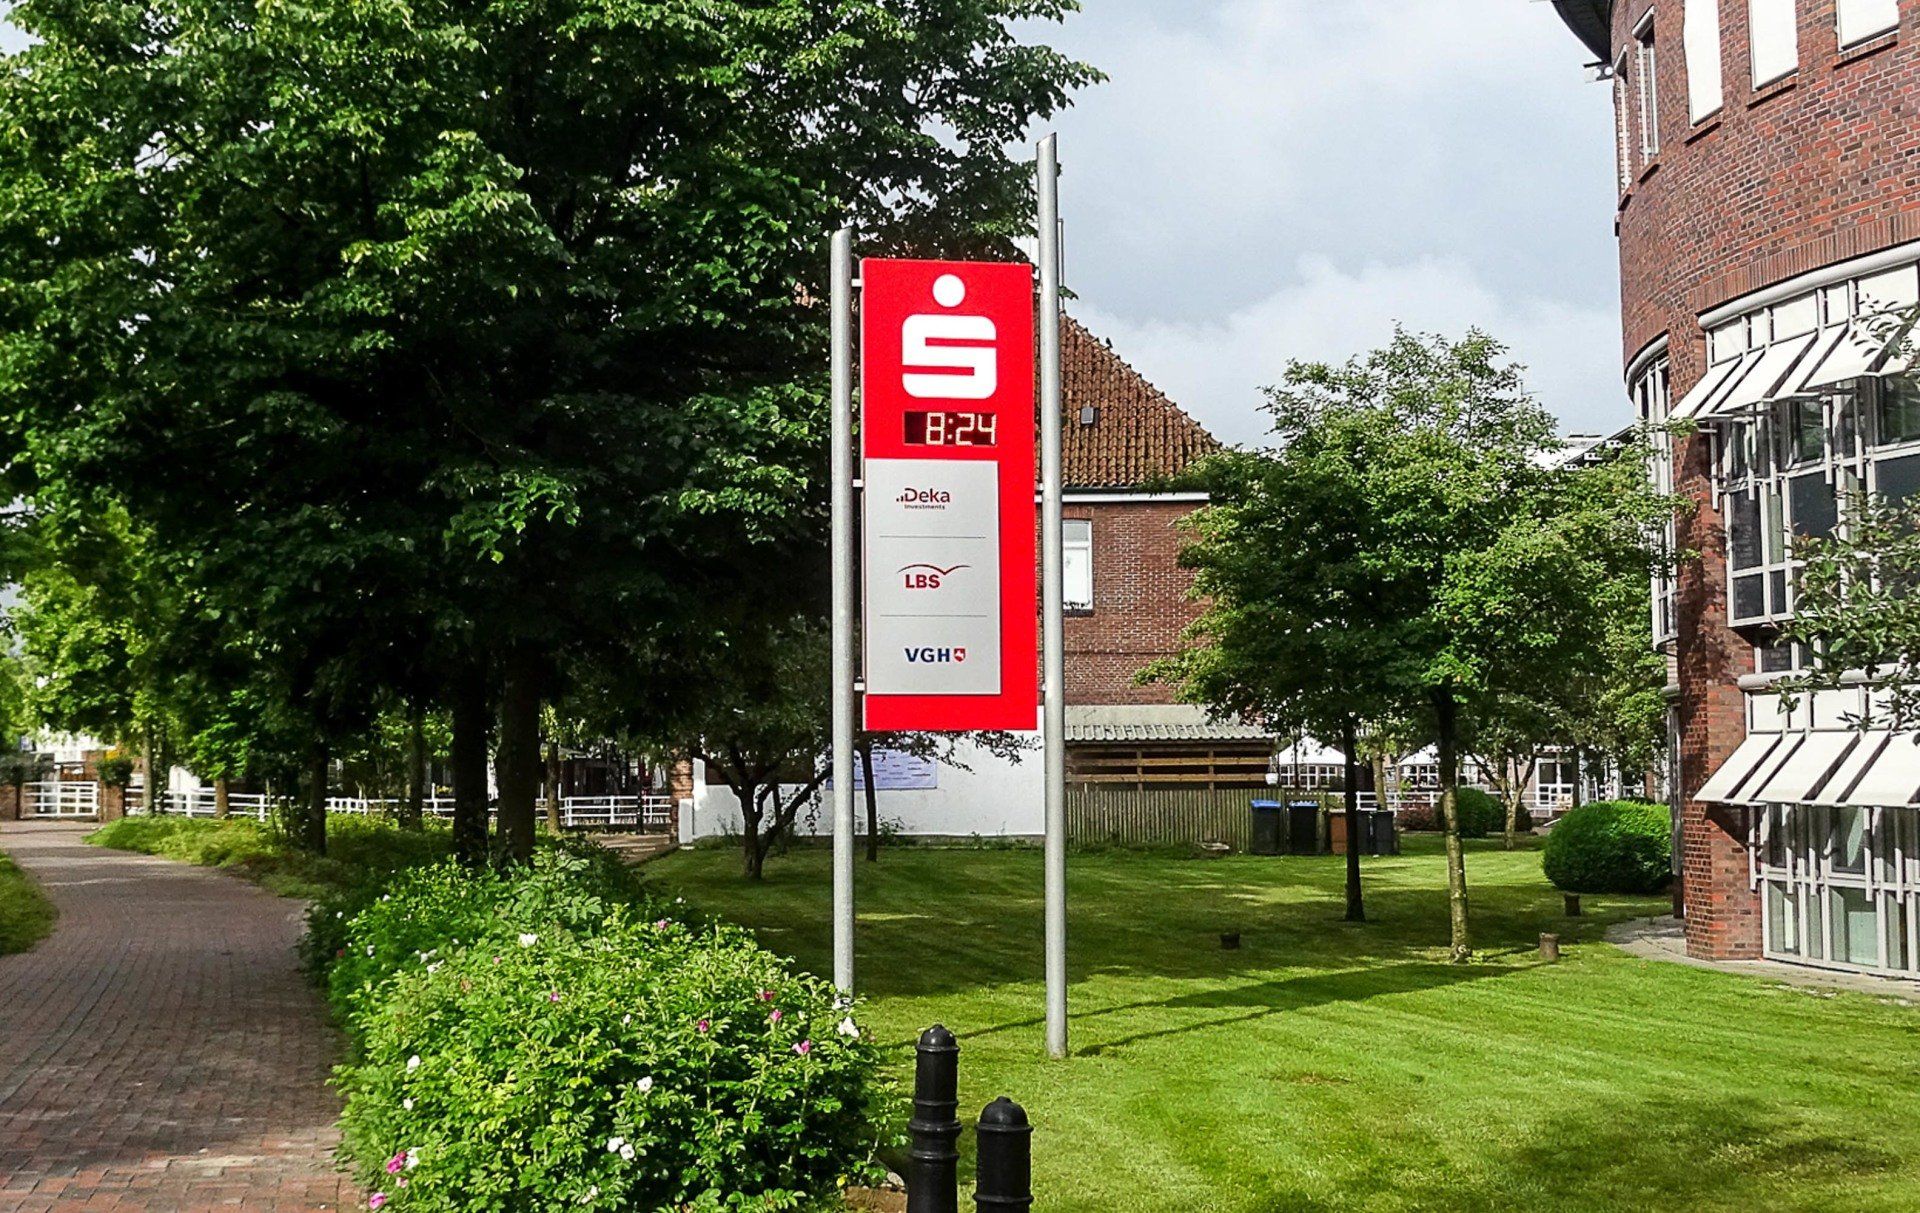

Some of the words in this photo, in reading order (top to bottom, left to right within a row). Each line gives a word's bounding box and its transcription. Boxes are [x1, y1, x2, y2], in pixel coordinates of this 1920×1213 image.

[926, 412, 997, 446] 8:24
[904, 487, 950, 503] Deka
[905, 574, 941, 589] LBS
[904, 647, 950, 663] VGH
